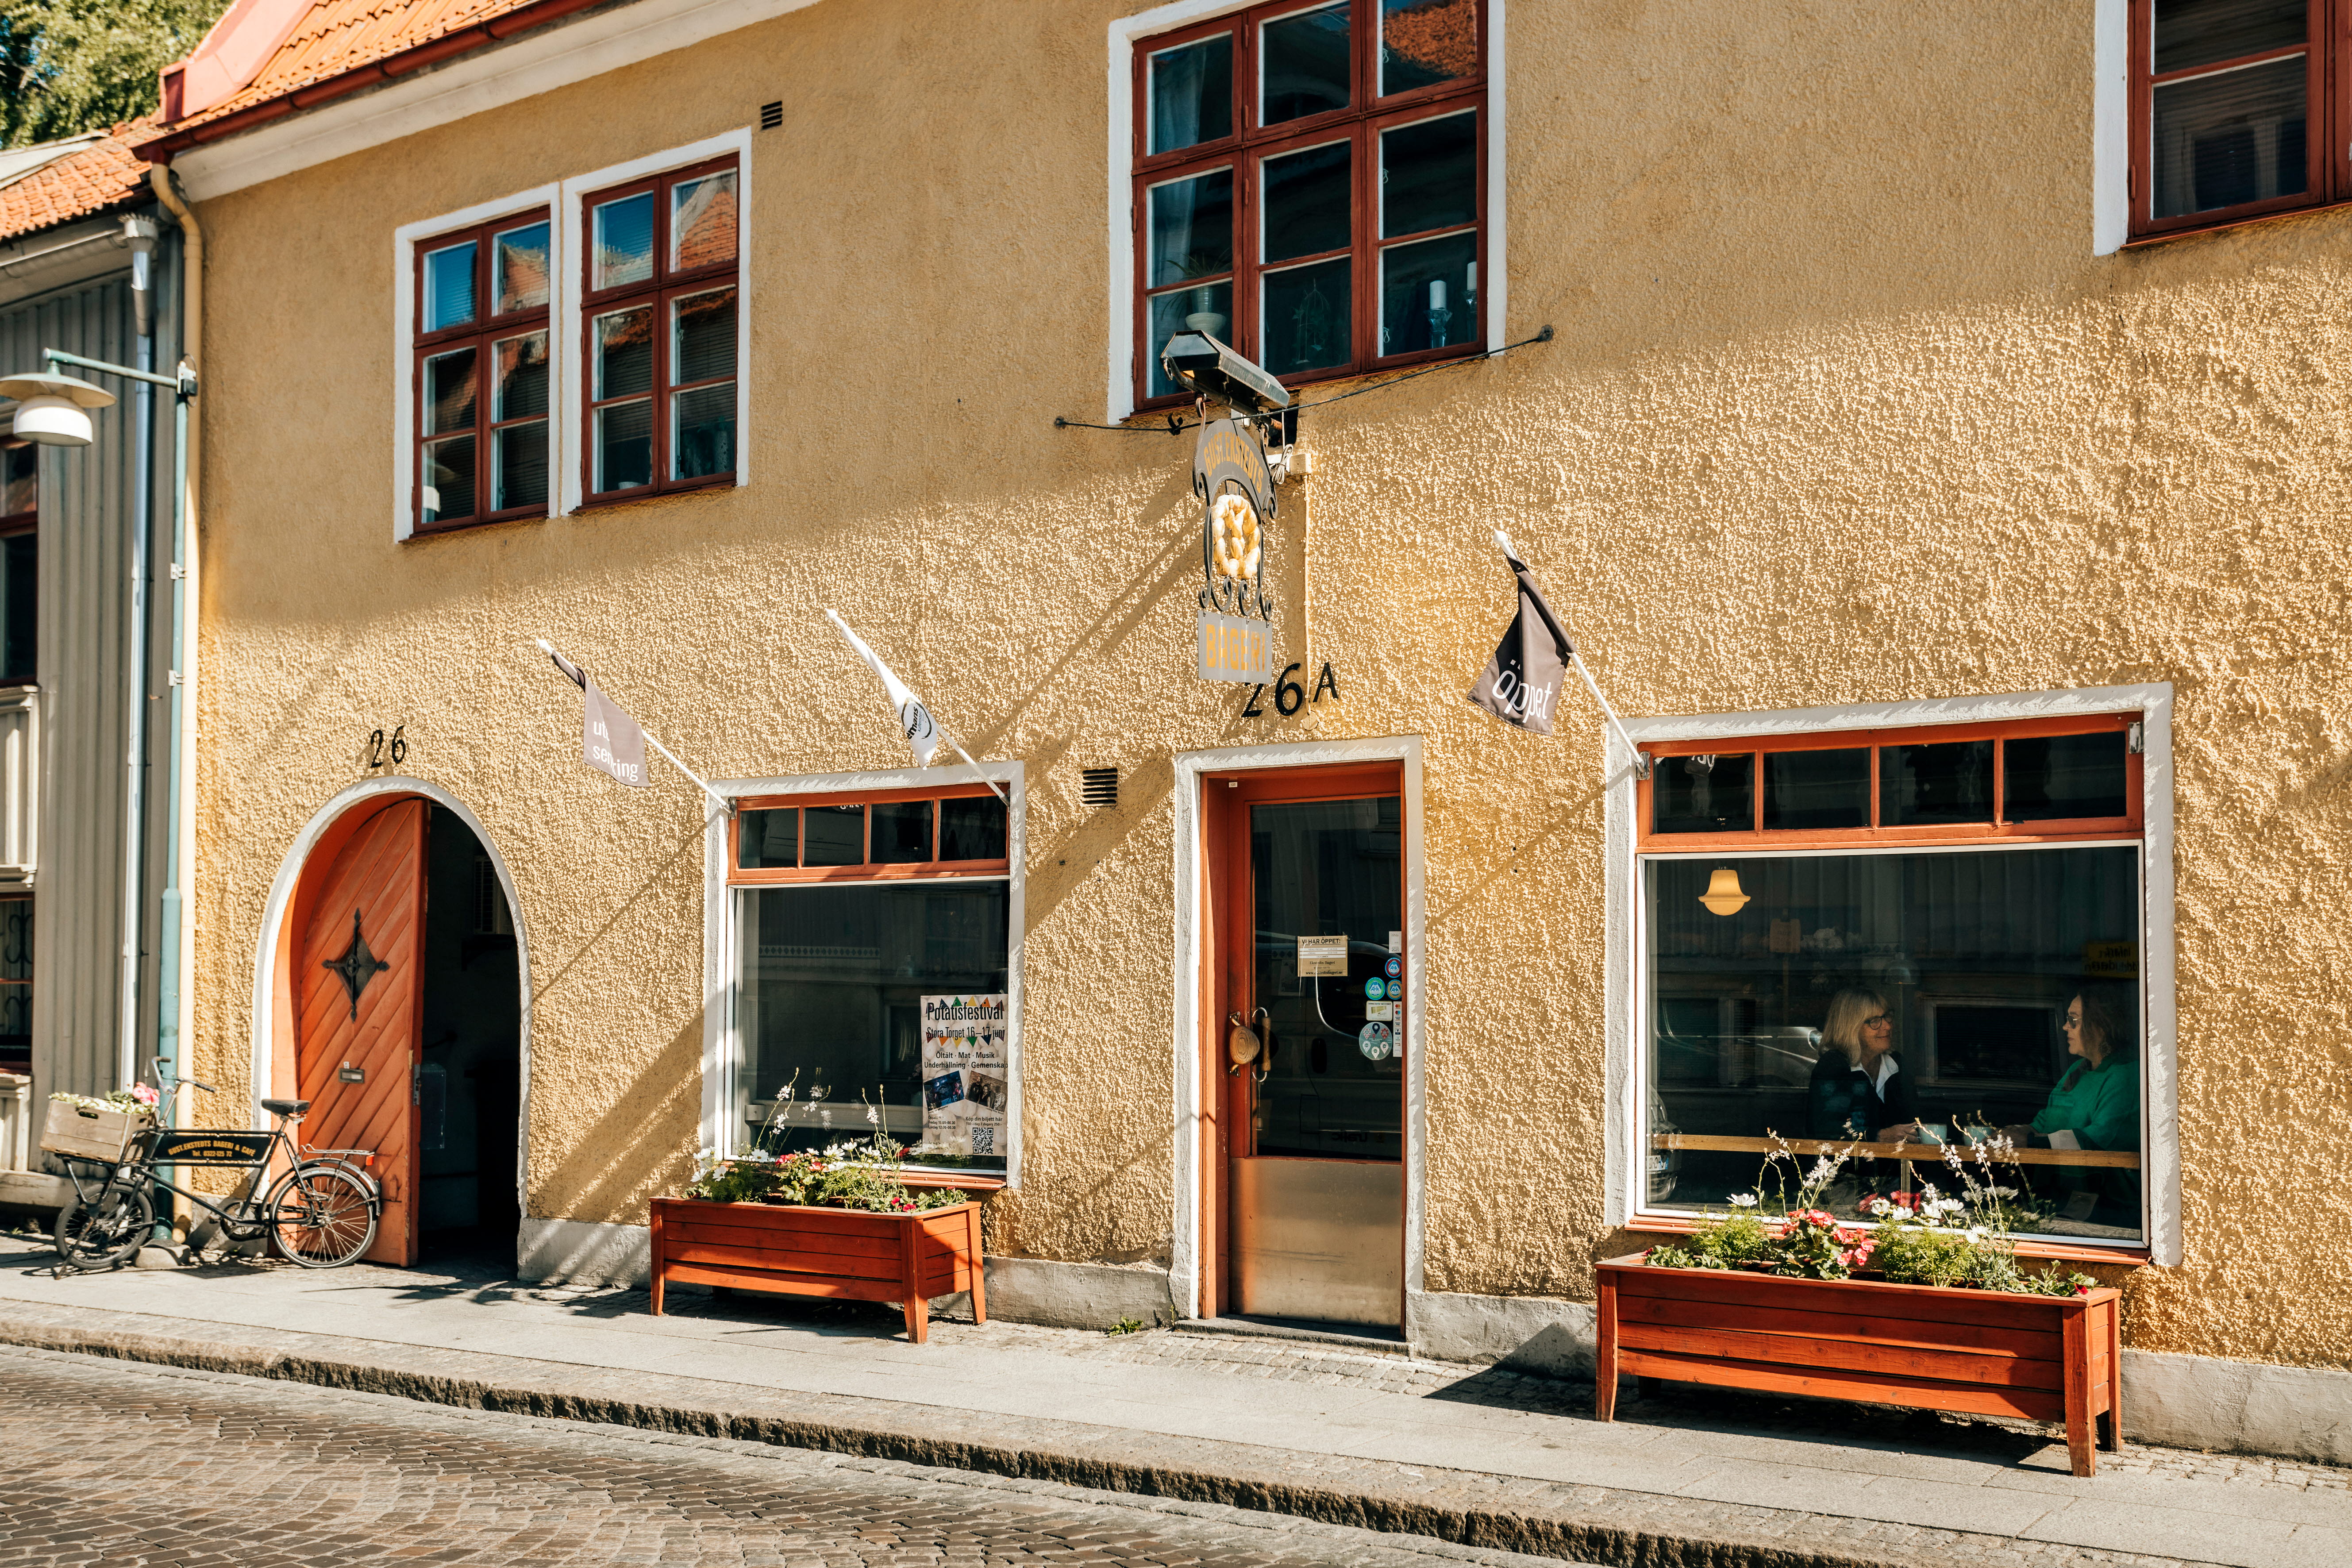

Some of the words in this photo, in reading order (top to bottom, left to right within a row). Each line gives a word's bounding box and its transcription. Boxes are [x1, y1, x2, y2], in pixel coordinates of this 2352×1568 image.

[1206, 624, 1265, 672] BAGERI
[1313, 662, 1339, 702] A
[370, 725, 406, 768] 26
[928, 1002, 1003, 1020] Potatisfestival
[927, 1027, 943, 1038] Stora
[945, 1027, 965, 1040] Torget
[992, 1026, 1005, 1040] juni
[213, 1140, 234, 1149] BAGERI
[241, 1146, 256, 1157] CAFÉ
